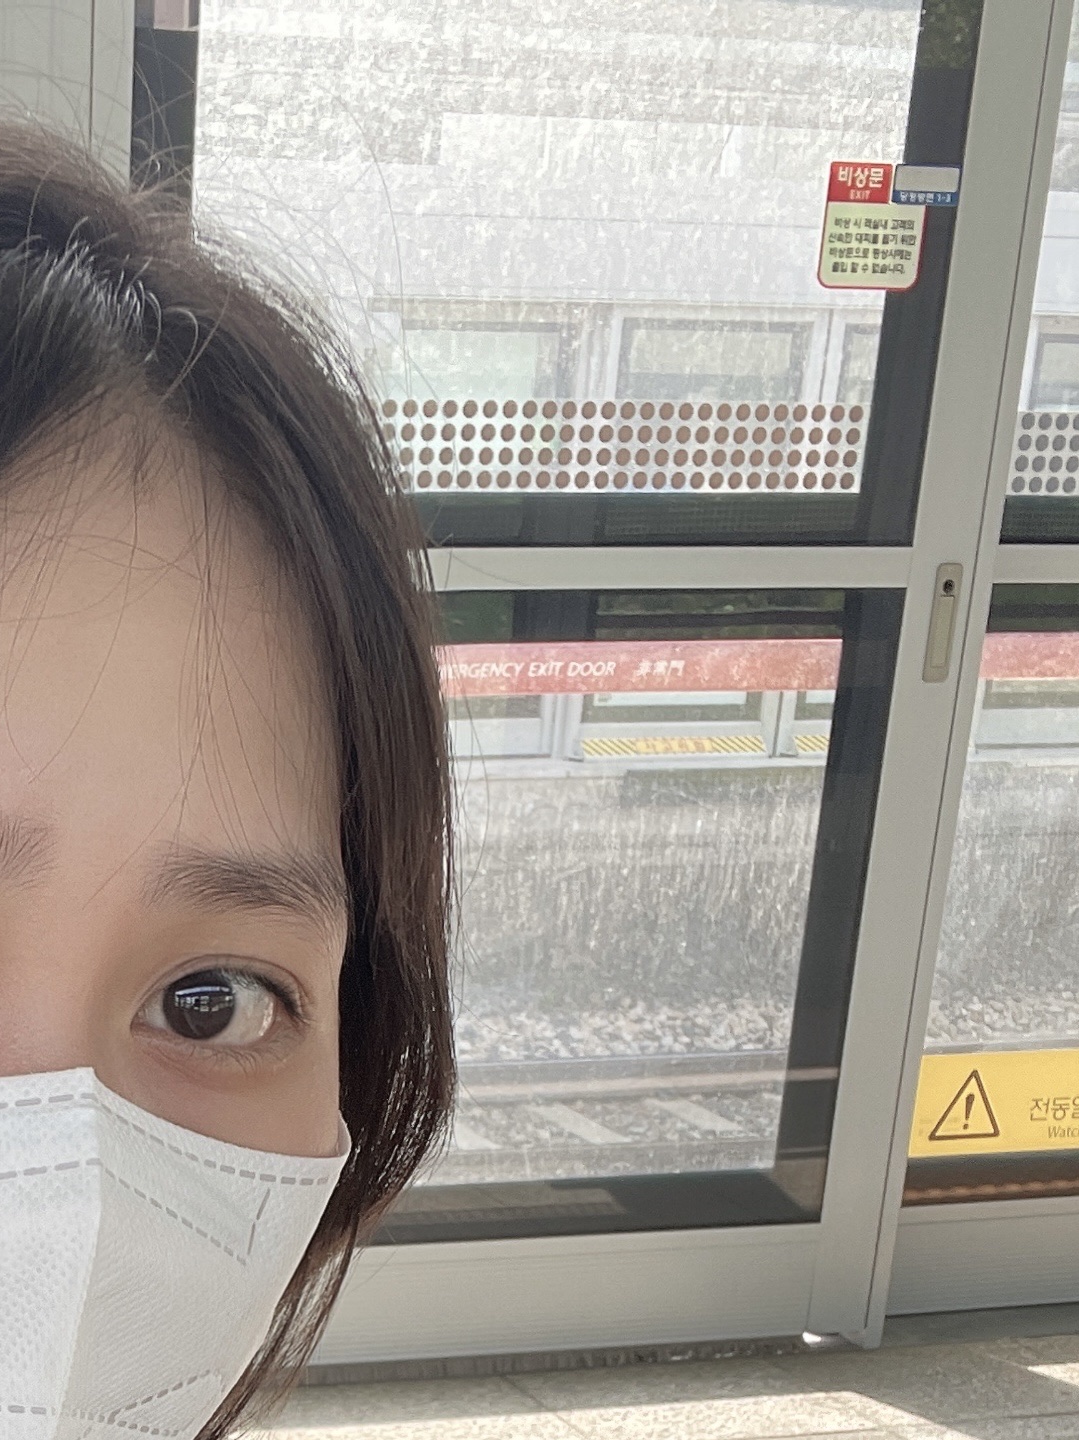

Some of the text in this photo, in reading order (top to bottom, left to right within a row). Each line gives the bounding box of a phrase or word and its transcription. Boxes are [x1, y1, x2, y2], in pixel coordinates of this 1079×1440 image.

[838, 166, 884, 188] 비상문
[850, 190, 871, 200] EXIT
[439, 661, 617, 680] ERGENCY EXIT DOOR
[1048, 1126, 1079, 1138] Watc
